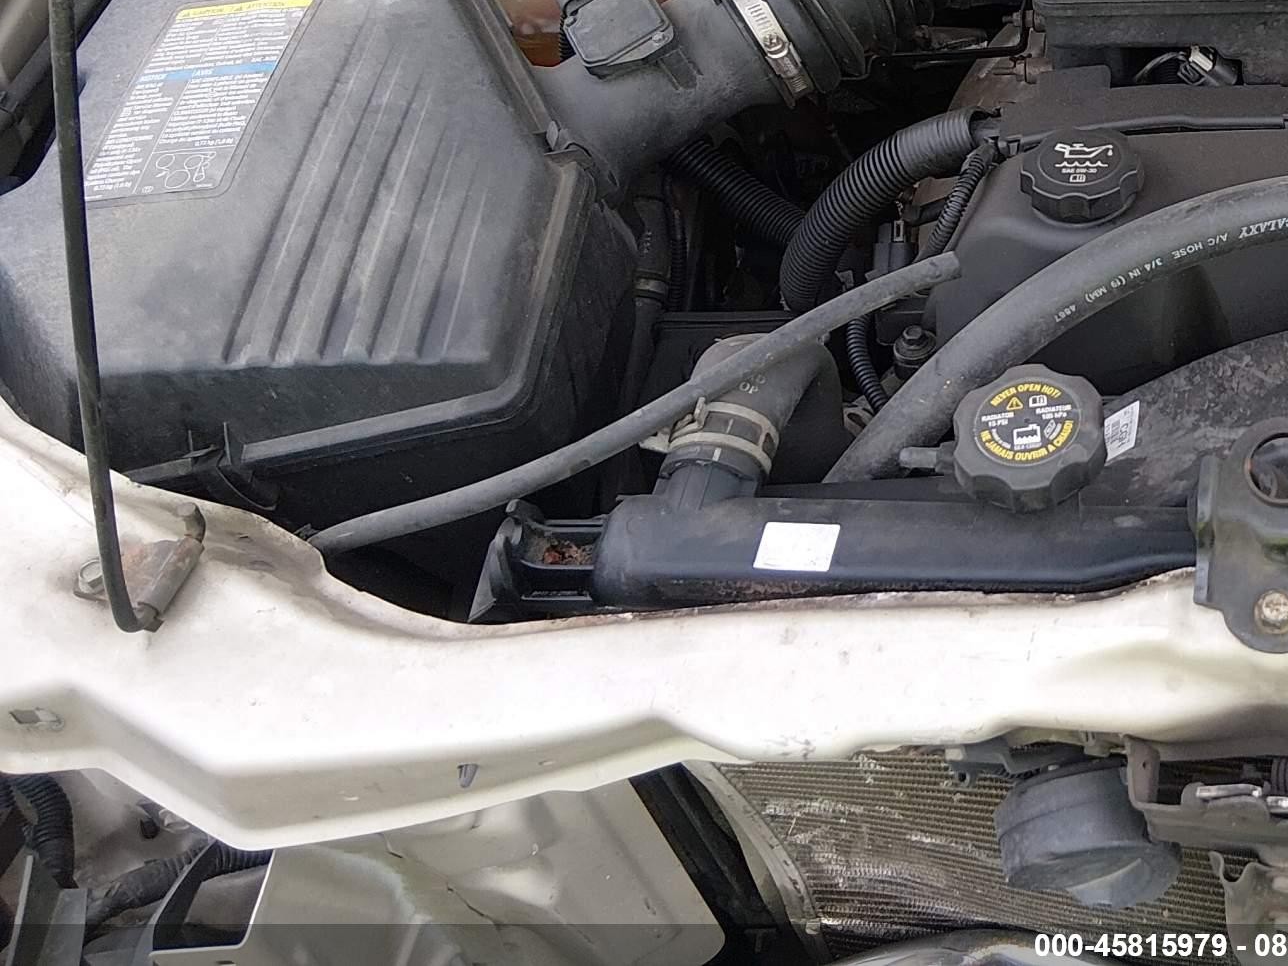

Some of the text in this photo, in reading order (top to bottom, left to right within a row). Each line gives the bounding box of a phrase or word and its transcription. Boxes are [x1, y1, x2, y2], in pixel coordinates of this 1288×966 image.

[1206, 231, 1228, 246] A/C
[1172, 240, 1205, 260] HOSE
[1144, 256, 1164, 272] 3/4
[990, 383, 1062, 406] NEVER OPEN HOT!
[981, 412, 1015, 422] RADIATOR
[984, 441, 1014, 460] JAMAIS
[1014, 448, 1048, 461] OUVRIR
